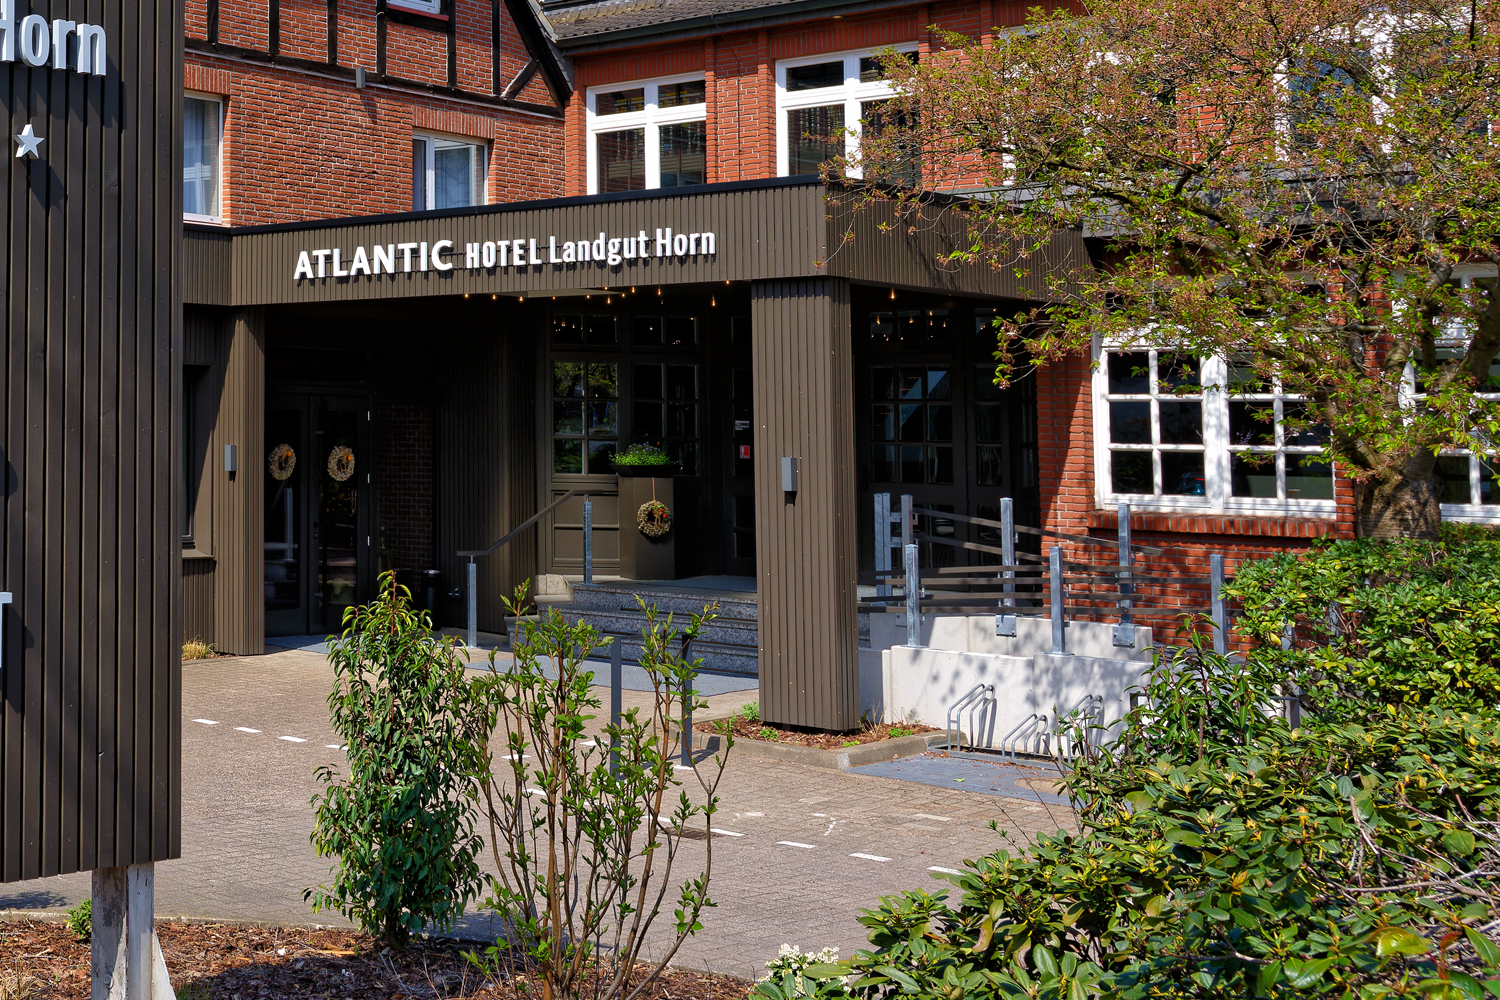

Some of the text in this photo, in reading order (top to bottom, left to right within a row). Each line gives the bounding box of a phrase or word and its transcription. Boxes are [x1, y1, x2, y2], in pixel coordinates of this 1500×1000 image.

[293, 227, 716, 280] ATLANTIC HOTEL Landgut Horn
